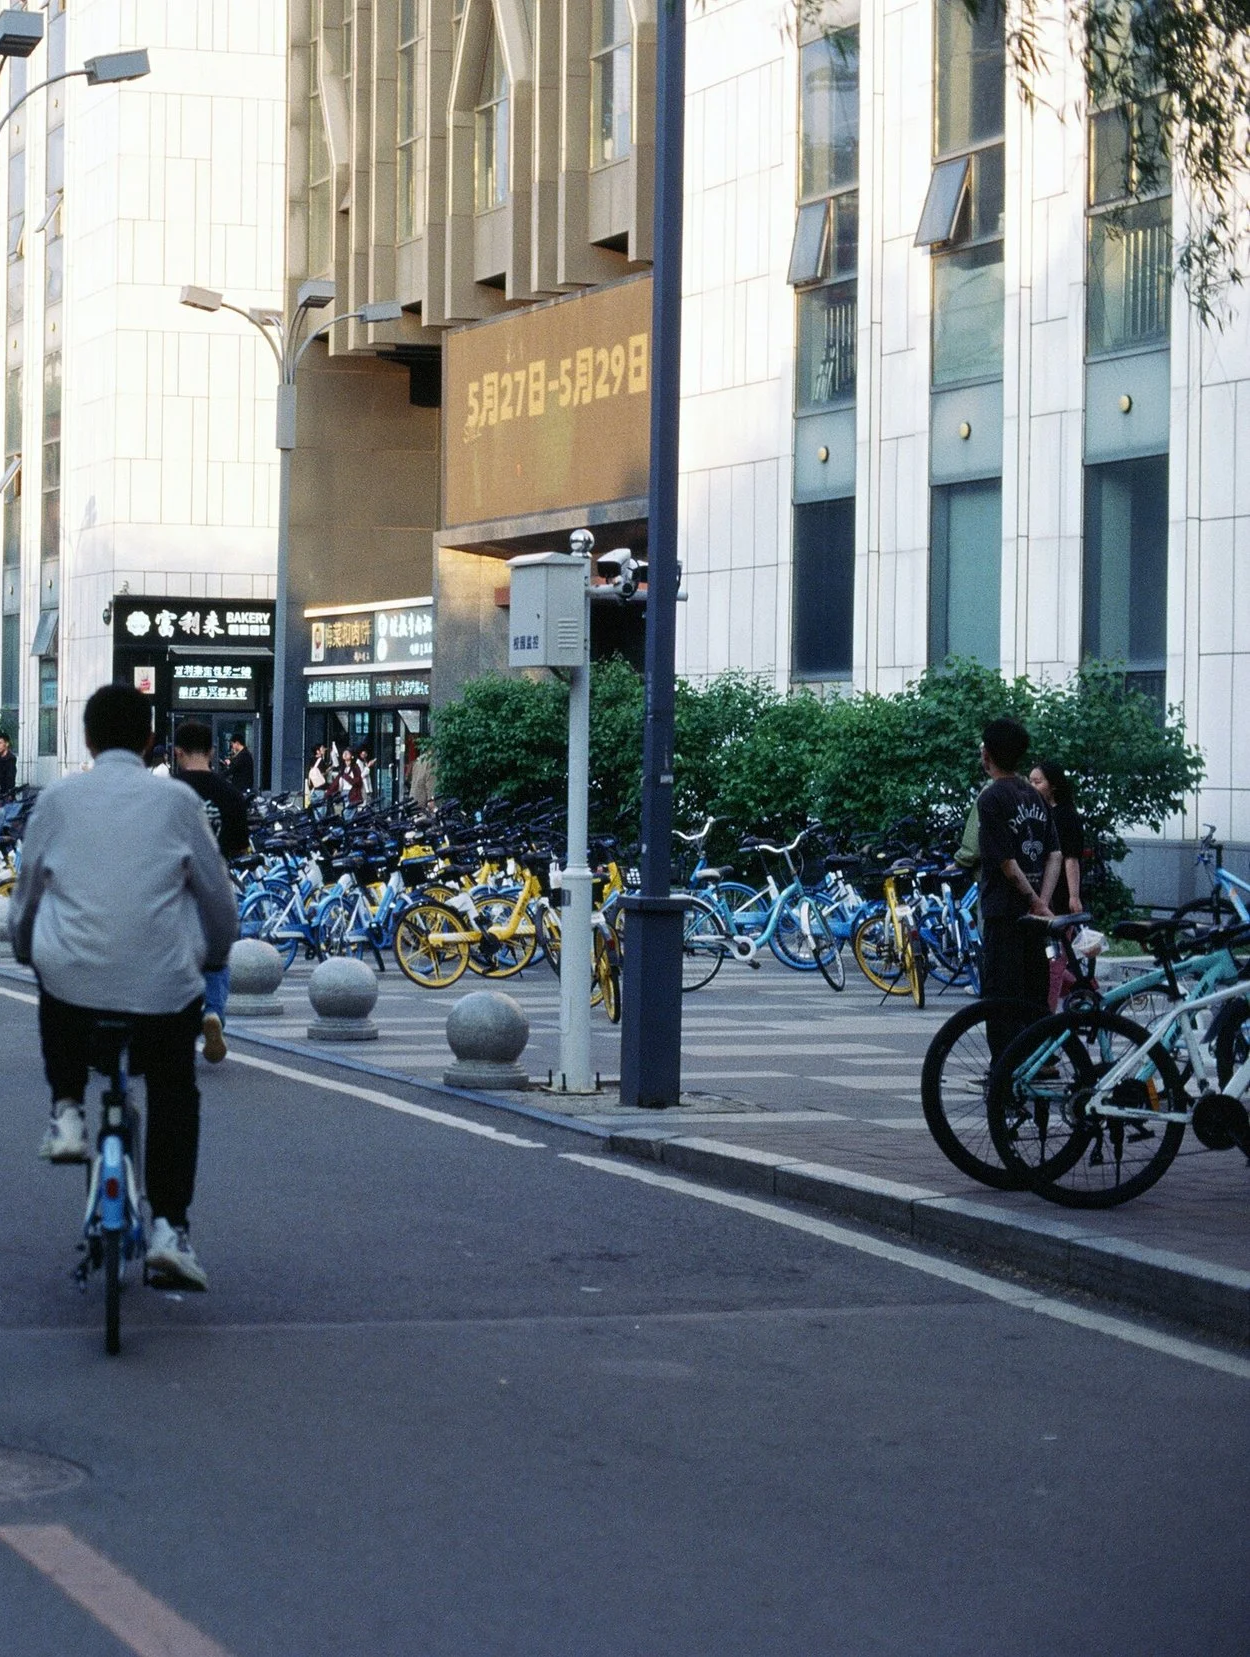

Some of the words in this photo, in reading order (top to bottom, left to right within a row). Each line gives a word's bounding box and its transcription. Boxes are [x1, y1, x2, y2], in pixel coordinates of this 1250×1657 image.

[466, 333, 648, 428] 5月27日-5月29日
[226, 612, 270, 624] BAKERY
